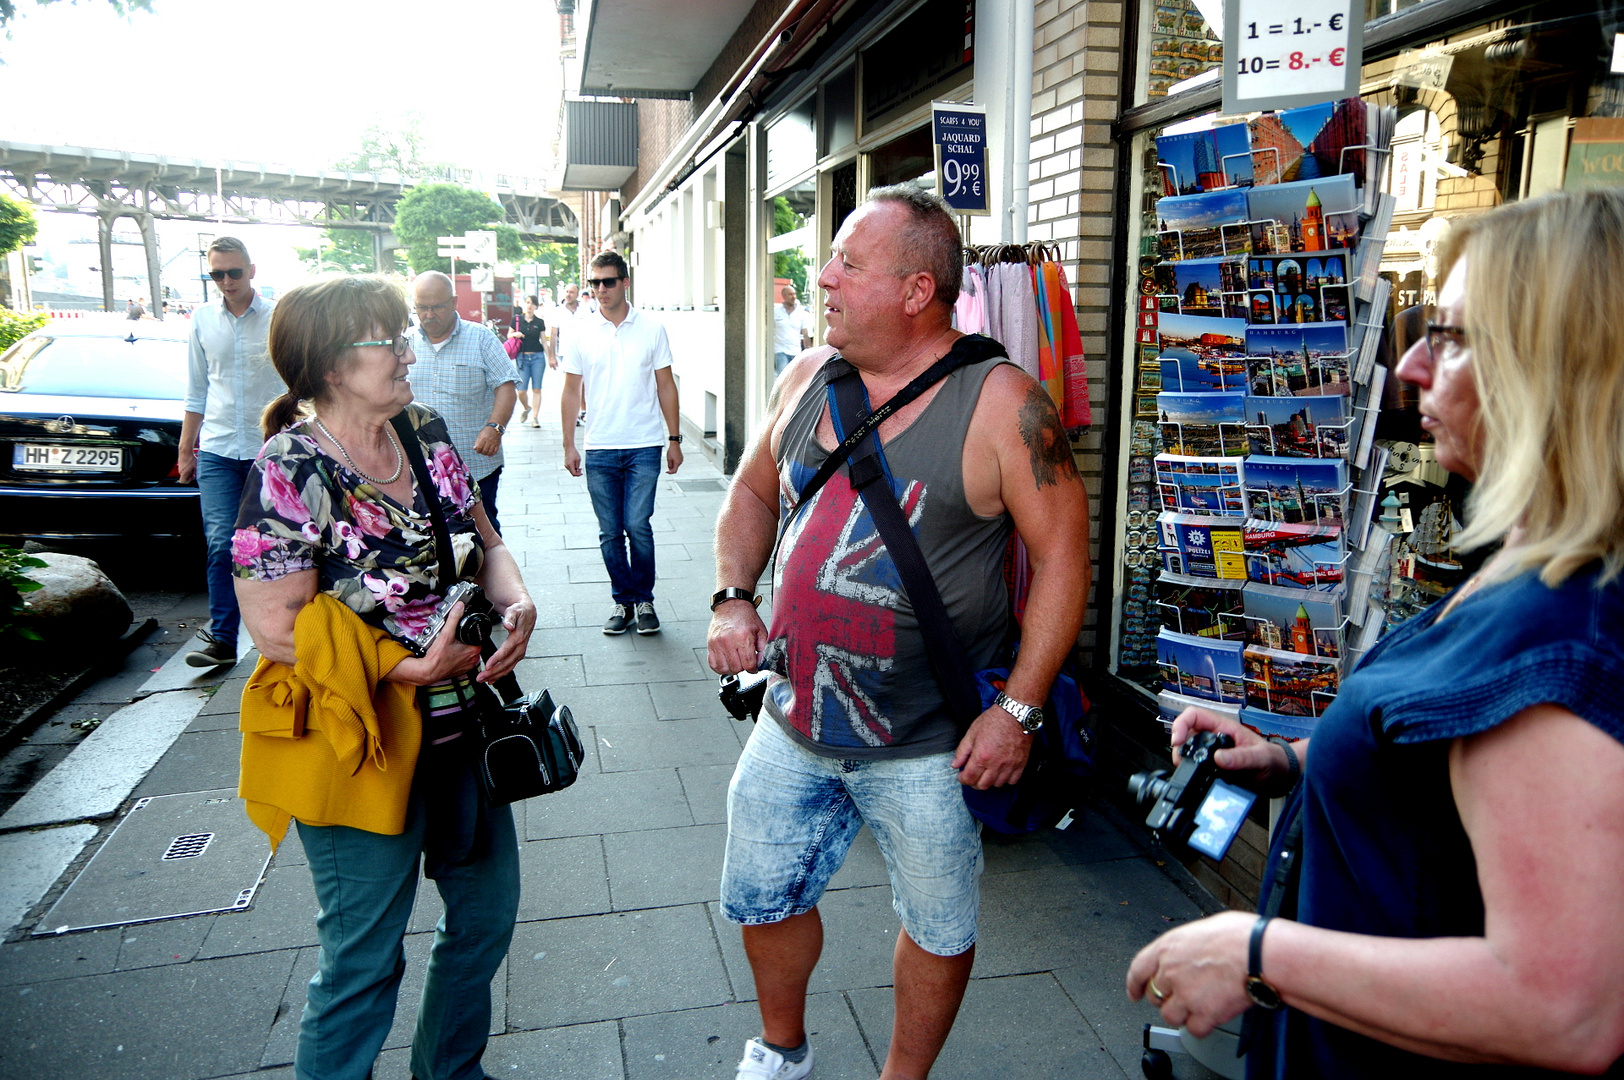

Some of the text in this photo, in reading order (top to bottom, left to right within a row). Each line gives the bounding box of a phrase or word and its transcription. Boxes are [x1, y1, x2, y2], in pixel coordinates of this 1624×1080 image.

[1247, 22, 1259, 39] 1
[1293, 17, 1321, 35] 1.-
[1328, 13, 1344, 31] €
[1288, 51, 1321, 70] 8.-
[1328, 47, 1345, 67] €
[940, 116, 959, 125] SCARFS
[941, 132, 981, 143] JAQUARD
[947, 144, 975, 154] SCHAL
[1398, 290, 1438, 307] ST. PA
[25, 447, 120, 466] HH Z 2295
[1244, 531, 1276, 540] HAMBURG
[1188, 547, 1211, 555] POLIZEI
[1190, 646, 1235, 657] HAMBURG
